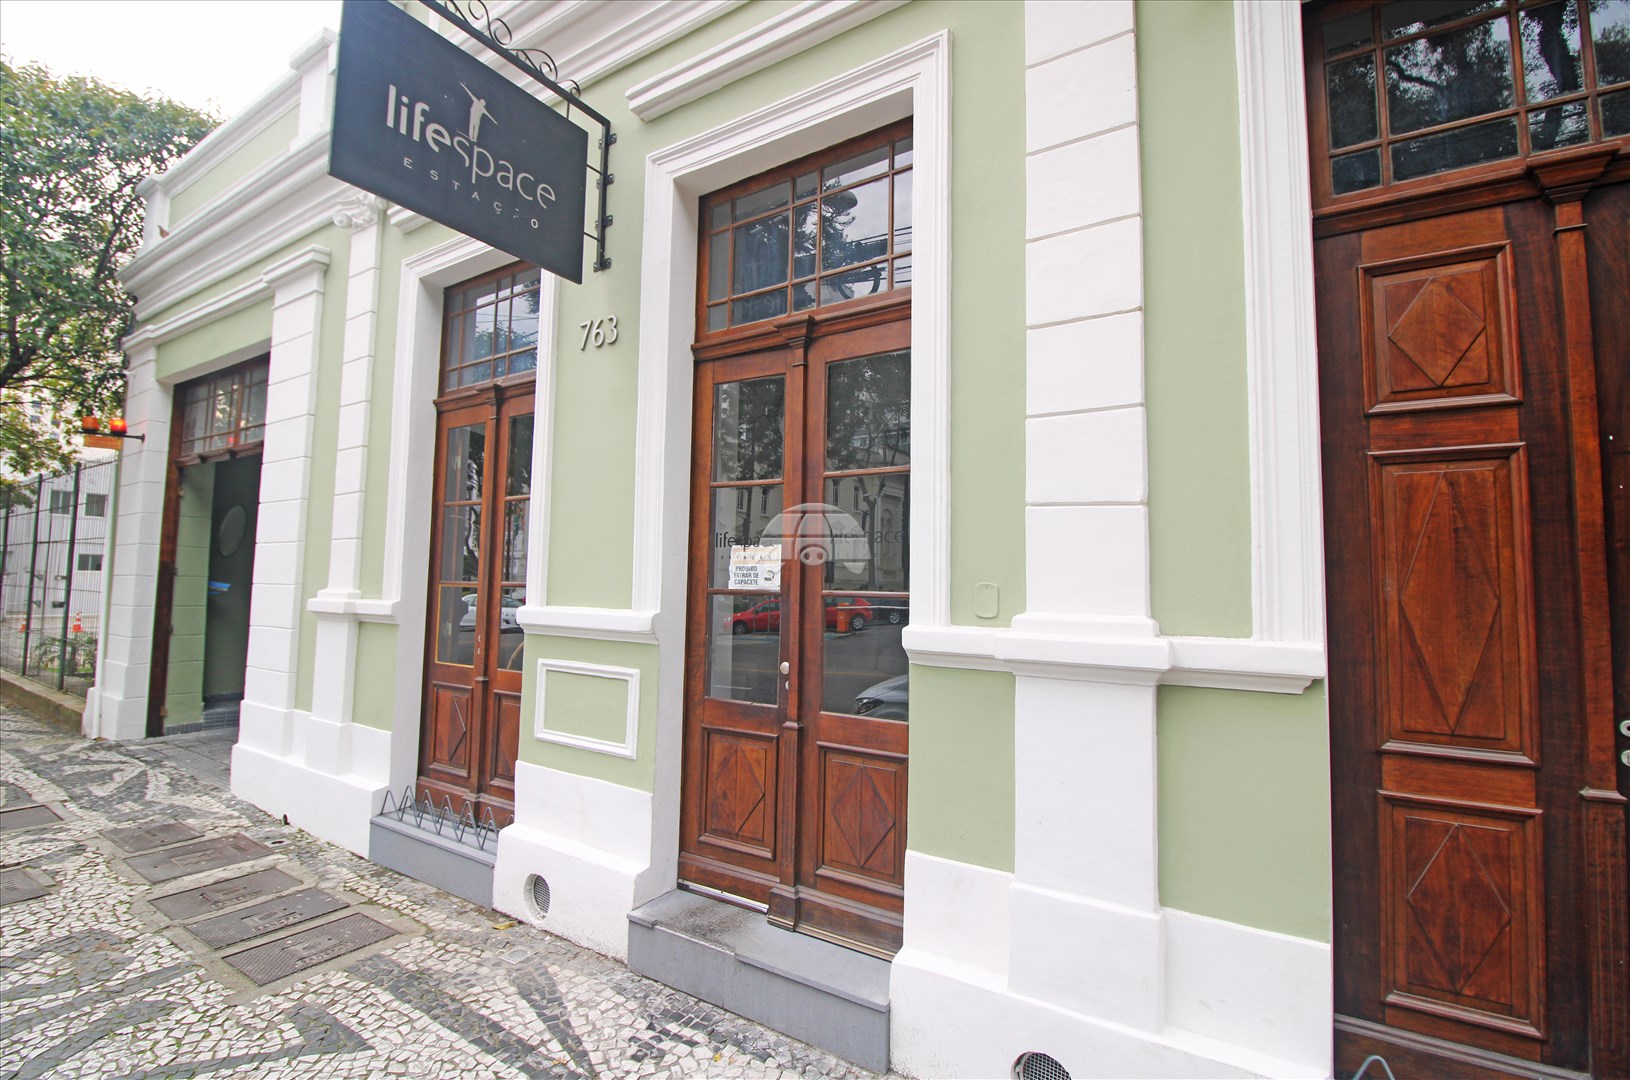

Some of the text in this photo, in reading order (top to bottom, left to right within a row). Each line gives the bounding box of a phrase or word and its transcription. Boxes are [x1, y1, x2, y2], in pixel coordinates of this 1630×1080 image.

[386, 83, 556, 209] lifespace
[403, 157, 539, 229] ESTAÇO
[579, 314, 618, 351] 763
[733, 578, 758, 586] CAPACETE
